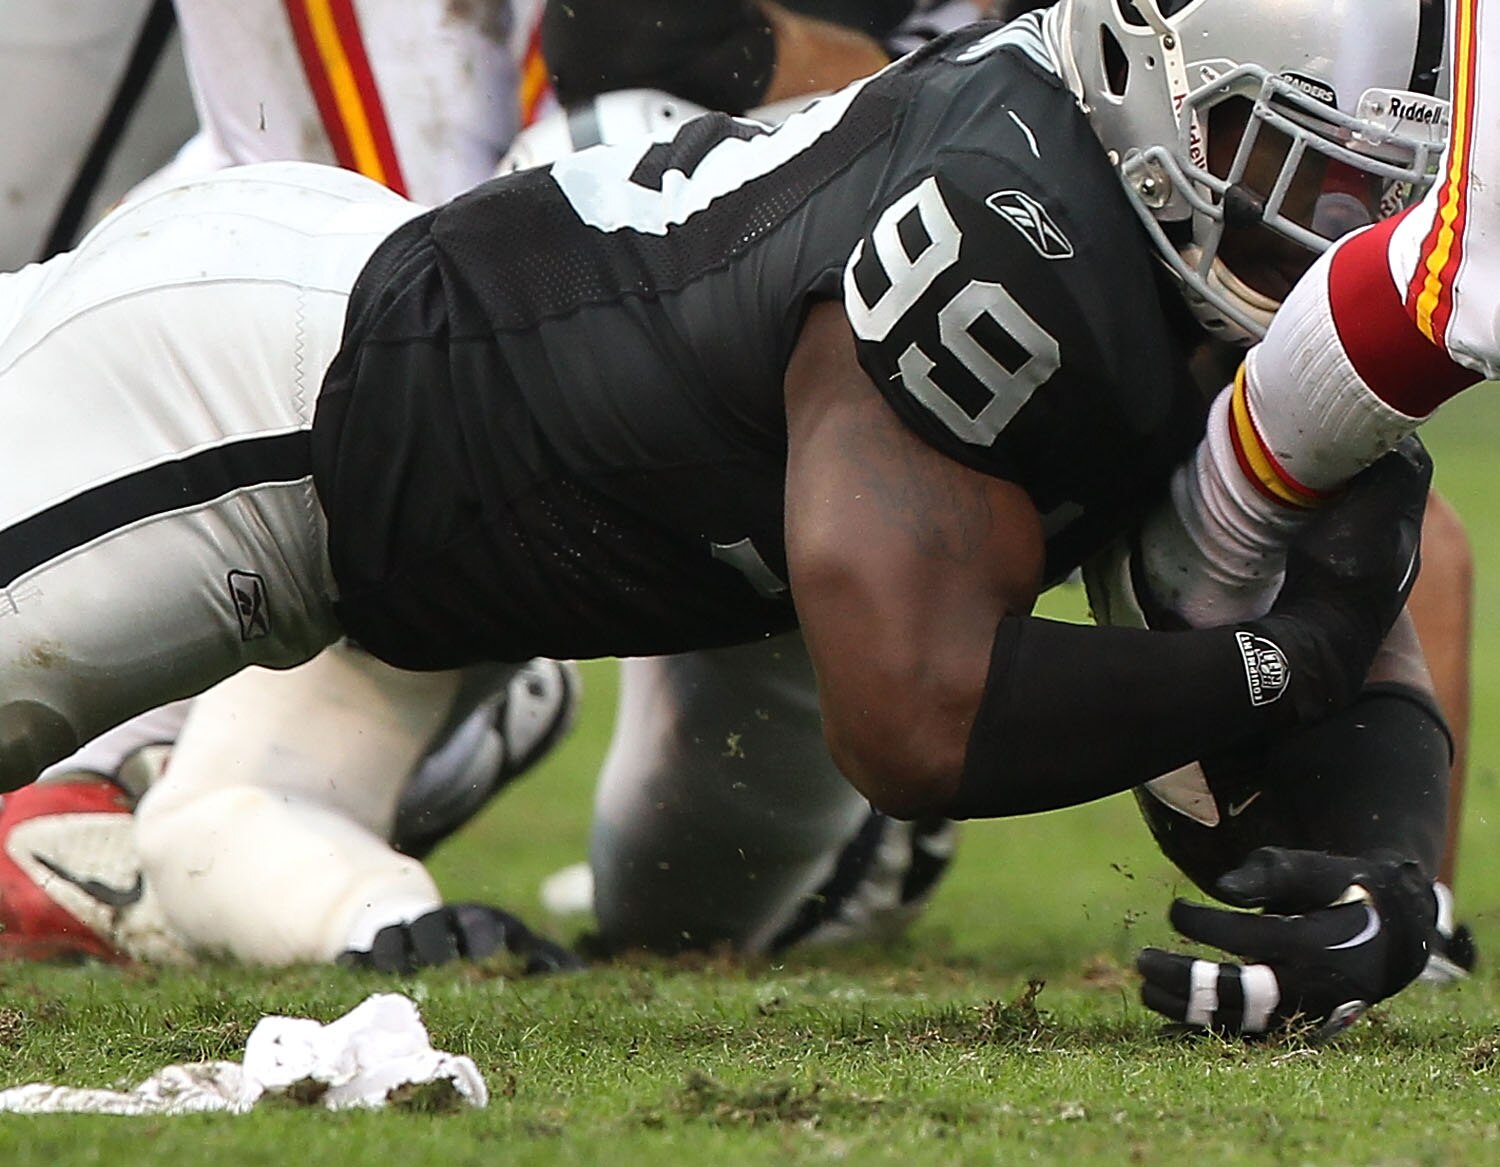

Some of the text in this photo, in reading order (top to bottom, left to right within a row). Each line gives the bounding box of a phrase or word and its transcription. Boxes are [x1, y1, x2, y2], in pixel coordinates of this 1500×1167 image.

[1283, 74, 1335, 103] RAIDERS
[1388, 96, 1443, 125] Riddell
[843, 176, 1062, 447] 99
[1241, 635, 1263, 701] EQUIPMENT
